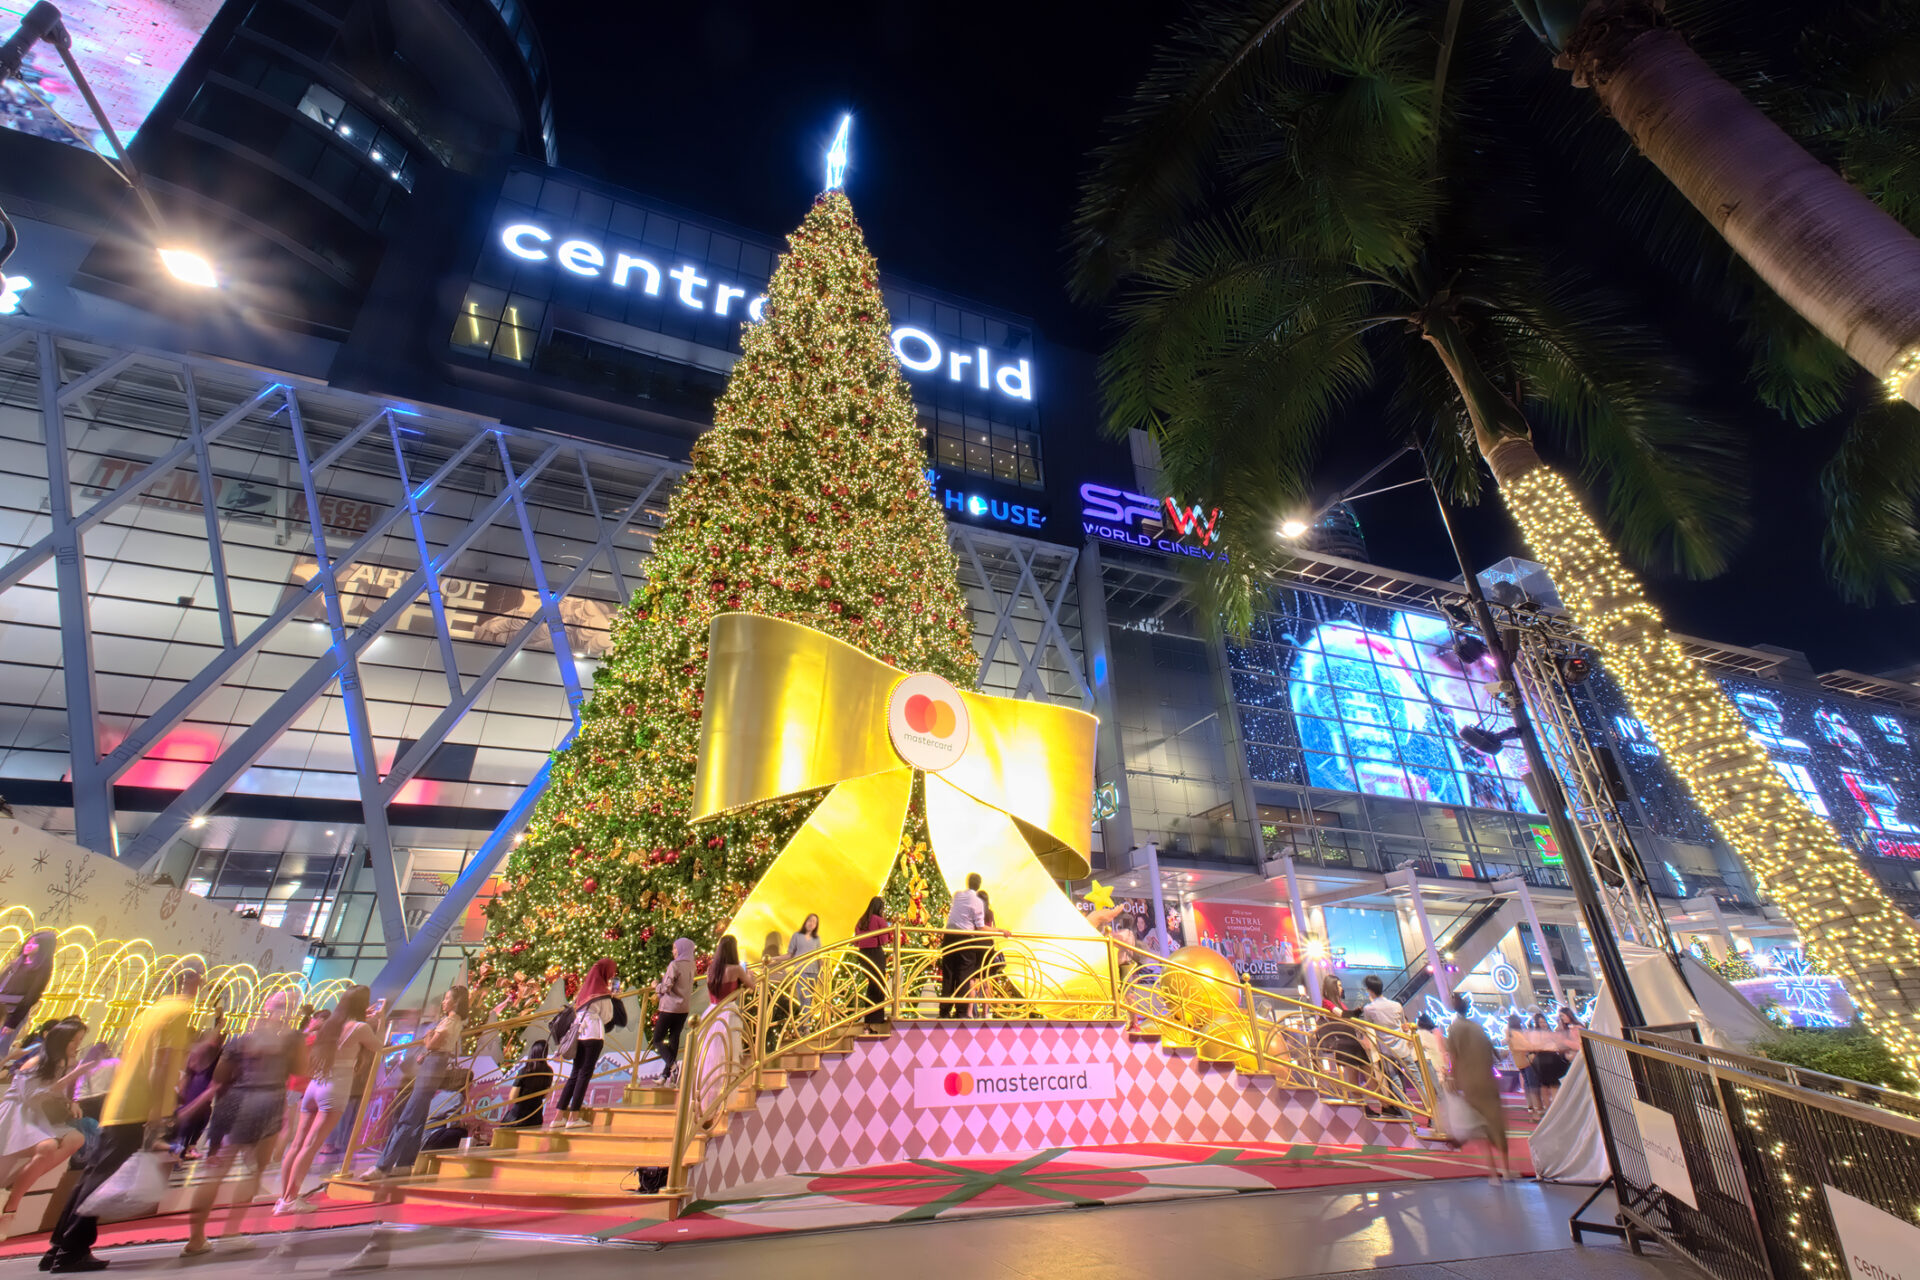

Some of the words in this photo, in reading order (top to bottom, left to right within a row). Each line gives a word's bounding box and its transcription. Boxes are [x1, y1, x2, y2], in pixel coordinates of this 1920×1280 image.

[1082, 521, 1151, 547] WORLD
[440, 578, 489, 600] OF
[340, 582, 485, 640] LFE
[903, 733, 953, 752] mastercard
[1224, 916, 1262, 926] CENTRAL
[1232, 961, 1279, 975] NCOVER
[976, 1070, 1088, 1094] mastercard
